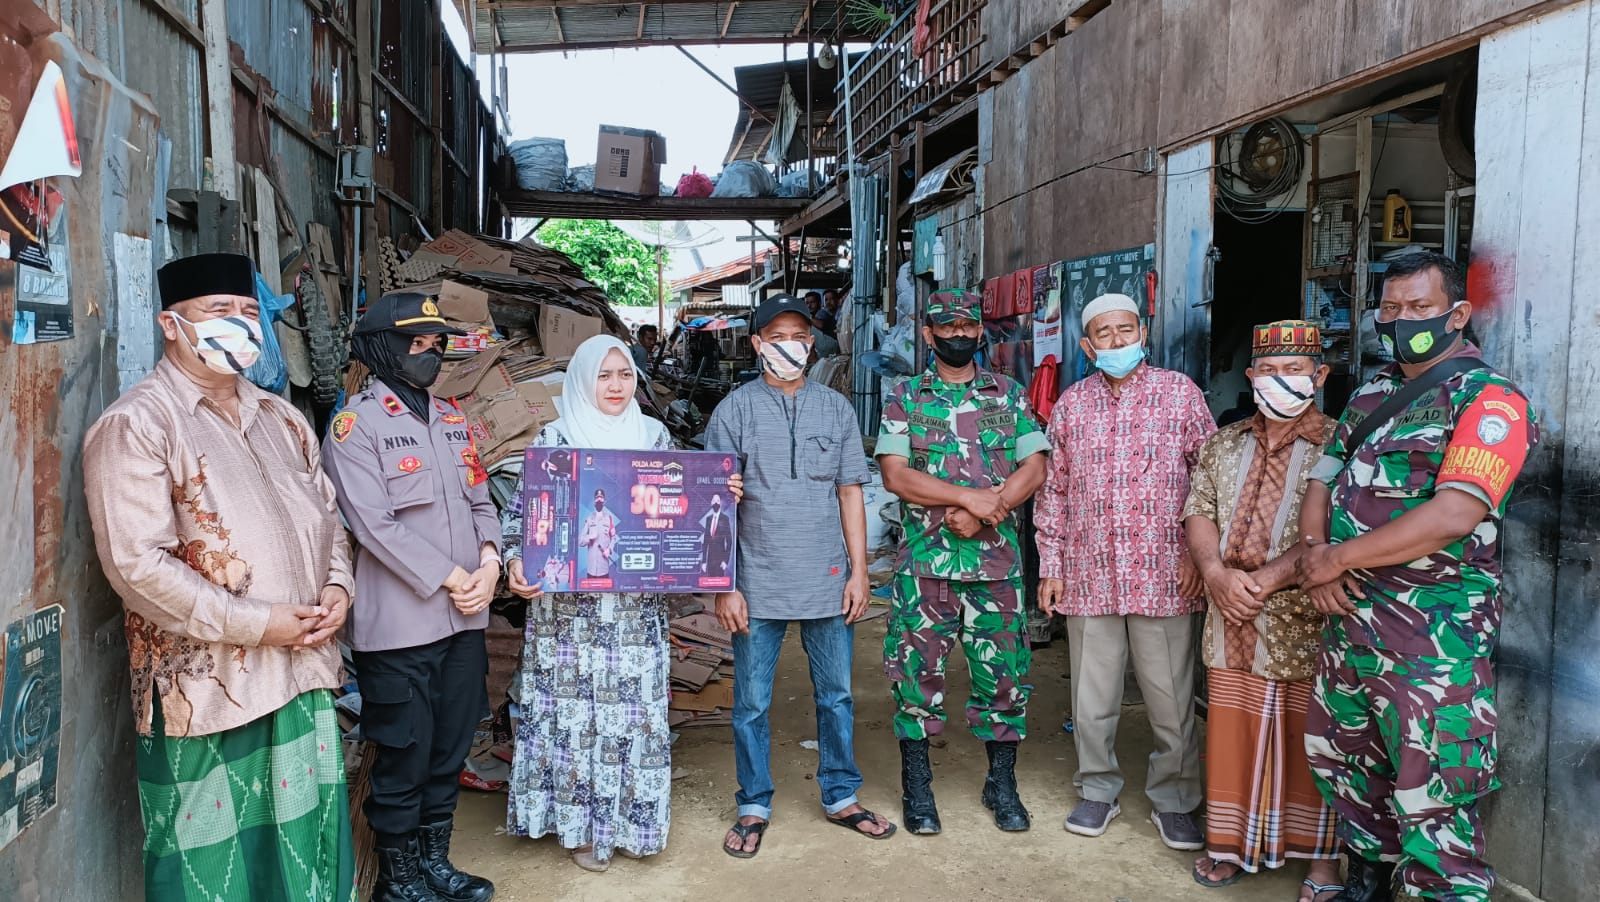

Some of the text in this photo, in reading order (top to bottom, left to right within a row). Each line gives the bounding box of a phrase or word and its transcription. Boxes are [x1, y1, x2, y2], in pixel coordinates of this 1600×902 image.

[912, 414, 947, 430] SULAIMAN
[981, 416, 1012, 428] TNI AD
[383, 435, 419, 450] NINA
[630, 484, 660, 515] 30
[660, 498, 680, 506] PAKET
[660, 506, 683, 514] UMRAH
[645, 519, 668, 529] TAHAP
[26, 612, 58, 644] MOVE
